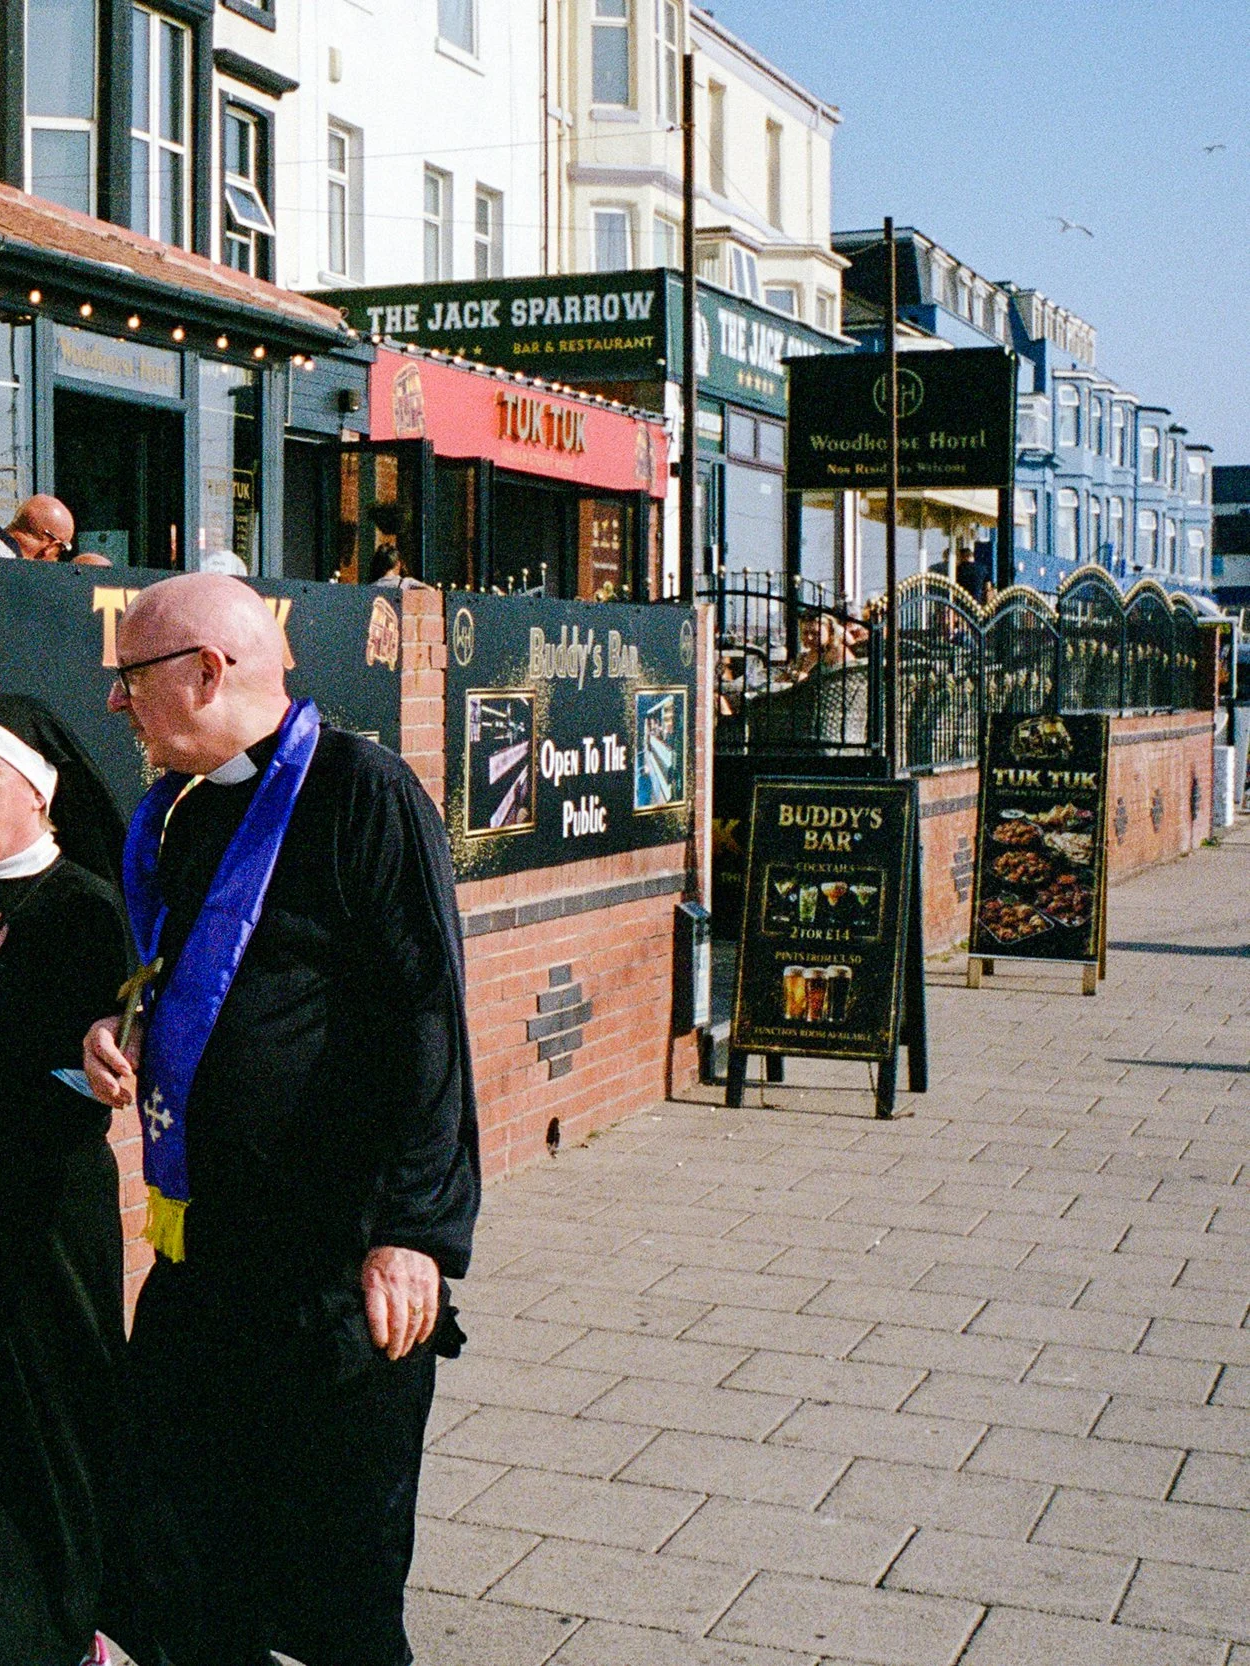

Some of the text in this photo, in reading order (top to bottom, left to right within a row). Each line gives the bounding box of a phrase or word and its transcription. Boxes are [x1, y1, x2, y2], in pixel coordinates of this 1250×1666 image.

[367, 290, 655, 335] THE JACK SPARROW
[512, 335, 655, 355] BAR & RESTAURANT
[499, 390, 587, 457] TUK TUK
[809, 432, 920, 452] Woodhose
[530, 625, 603, 691] Buddy's
[540, 733, 627, 787] Open To The
[992, 768, 1097, 790] TUK TUK
[562, 795, 607, 838] Public
[778, 803, 883, 829] BUDDY'S
[803, 829, 851, 852] BAR
[790, 925, 851, 941] 2 FOR £14
